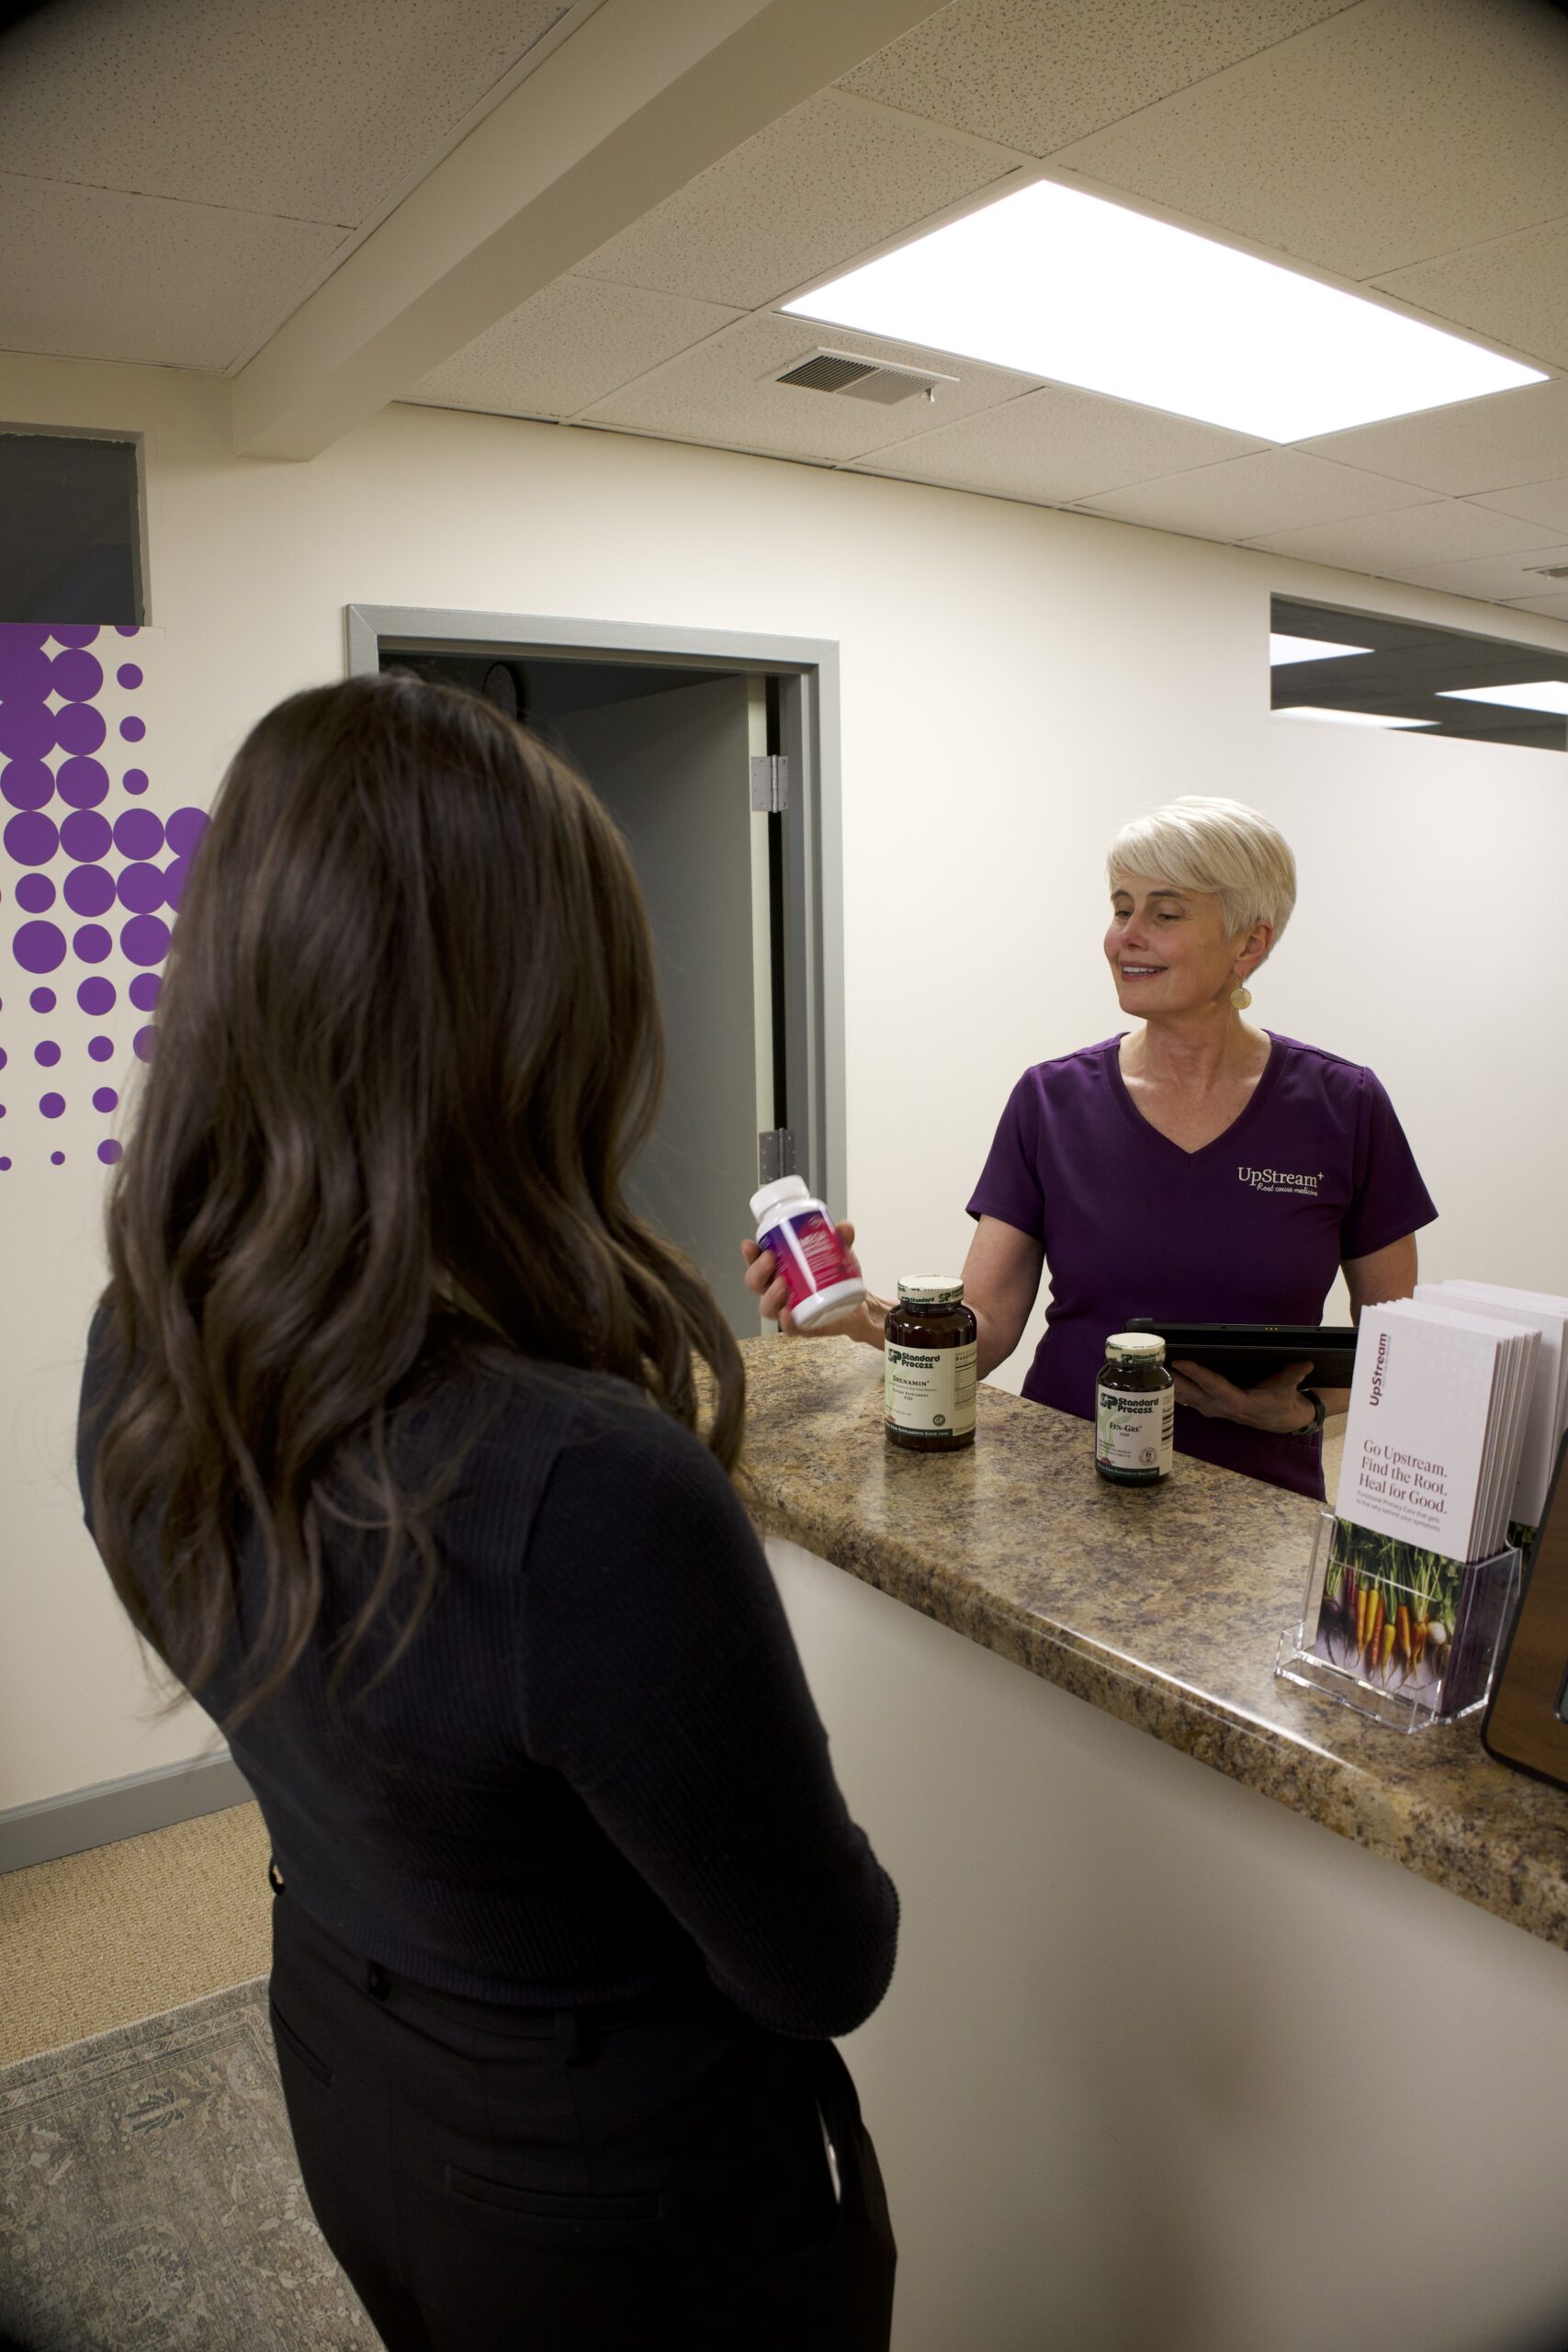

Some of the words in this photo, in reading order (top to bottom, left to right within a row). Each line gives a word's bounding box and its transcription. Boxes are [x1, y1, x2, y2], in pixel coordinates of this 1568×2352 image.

[1257, 1182, 1274, 1193] Root
[1293, 1185, 1318, 1197] medicine
[901, 1352, 941, 1363] Standard
[901, 1360, 934, 1369] Process
[1369, 1333, 1388, 1407] UpStream
[1117, 1397, 1159, 1407] Standard
[1117, 1405, 1153, 1414] Process
[1363, 1439, 1382, 1456] Go
[1383, 1445, 1448, 1477] Upstream.
[1361, 1456, 1388, 1476] Find
[1391, 1467, 1411, 1484] the
[1414, 1473, 1448, 1497] Root.
[1359, 1473, 1386, 1494] Heal
[1389, 1483, 1406, 1500] for
[1408, 1489, 1447, 1514] Good.
